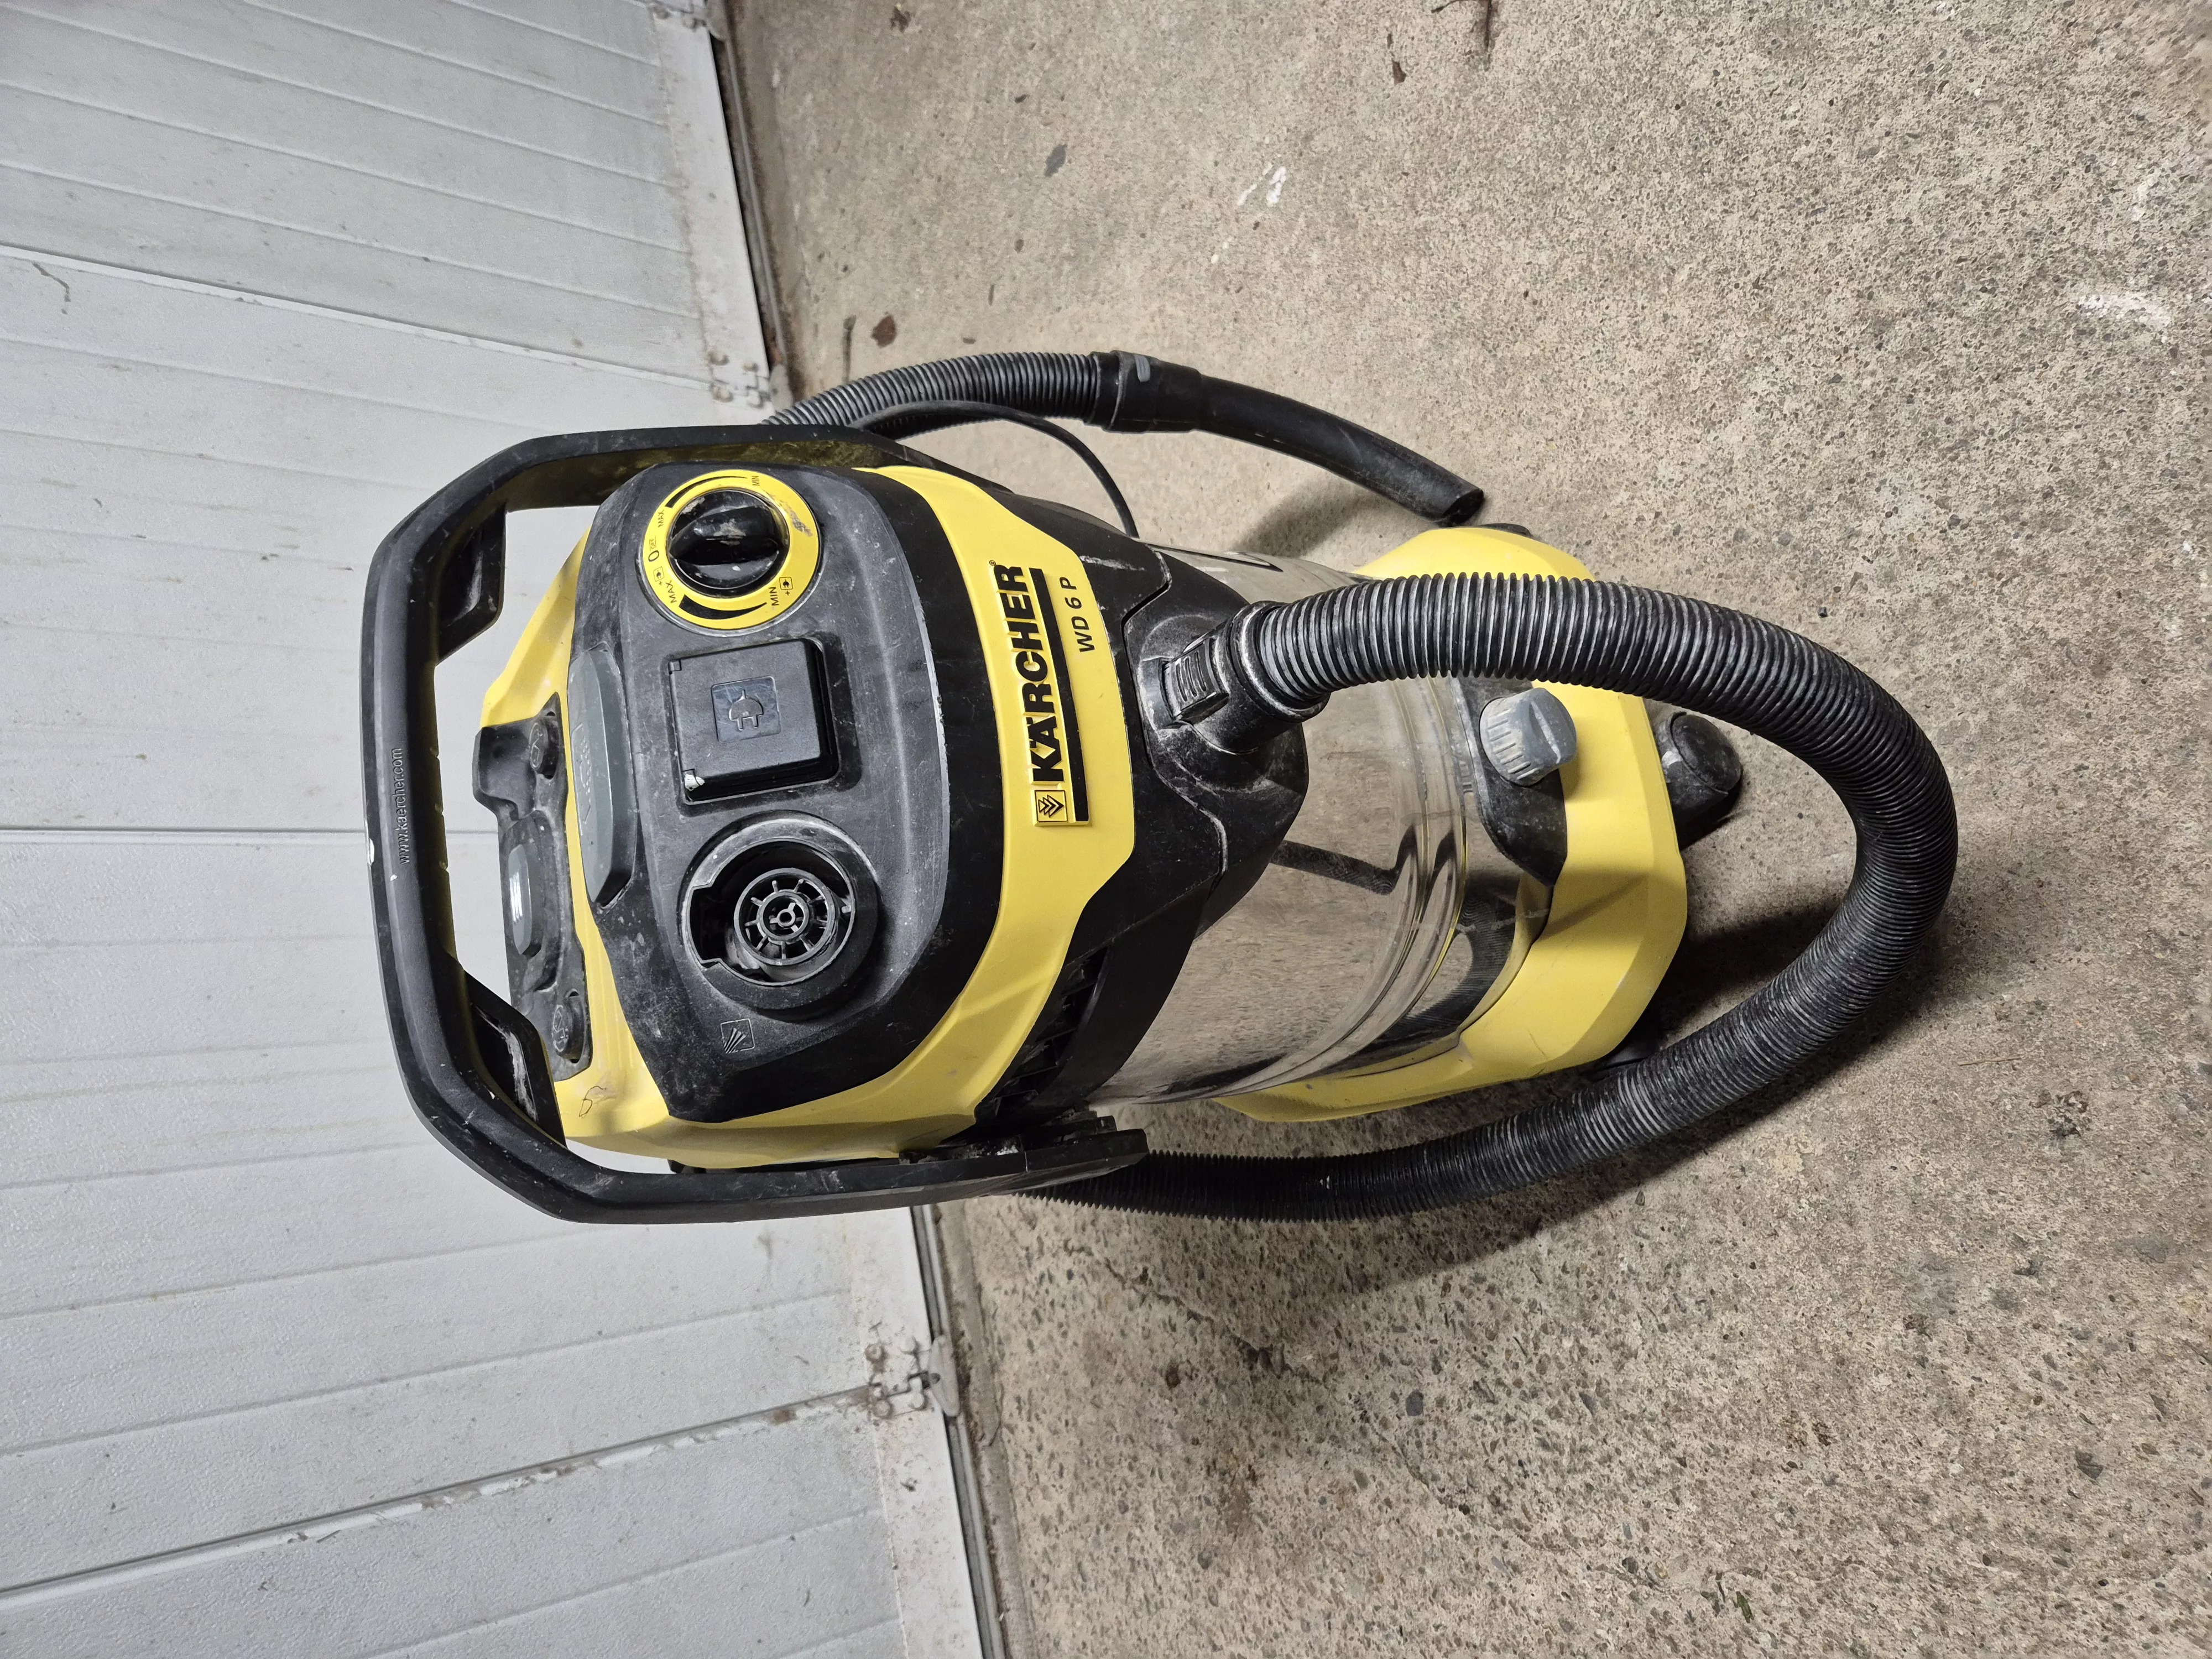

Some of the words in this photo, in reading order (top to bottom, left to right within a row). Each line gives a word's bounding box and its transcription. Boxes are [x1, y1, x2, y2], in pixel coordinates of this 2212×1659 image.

[752, 476, 761, 486] MIN
[665, 580, 677, 603] MAX
[1059, 576, 1077, 590] P
[769, 586, 780, 607] MIN
[1065, 597, 1083, 609] 6
[1071, 616, 1095, 653] WD
[391, 748, 410, 865] www.kaercher.com
